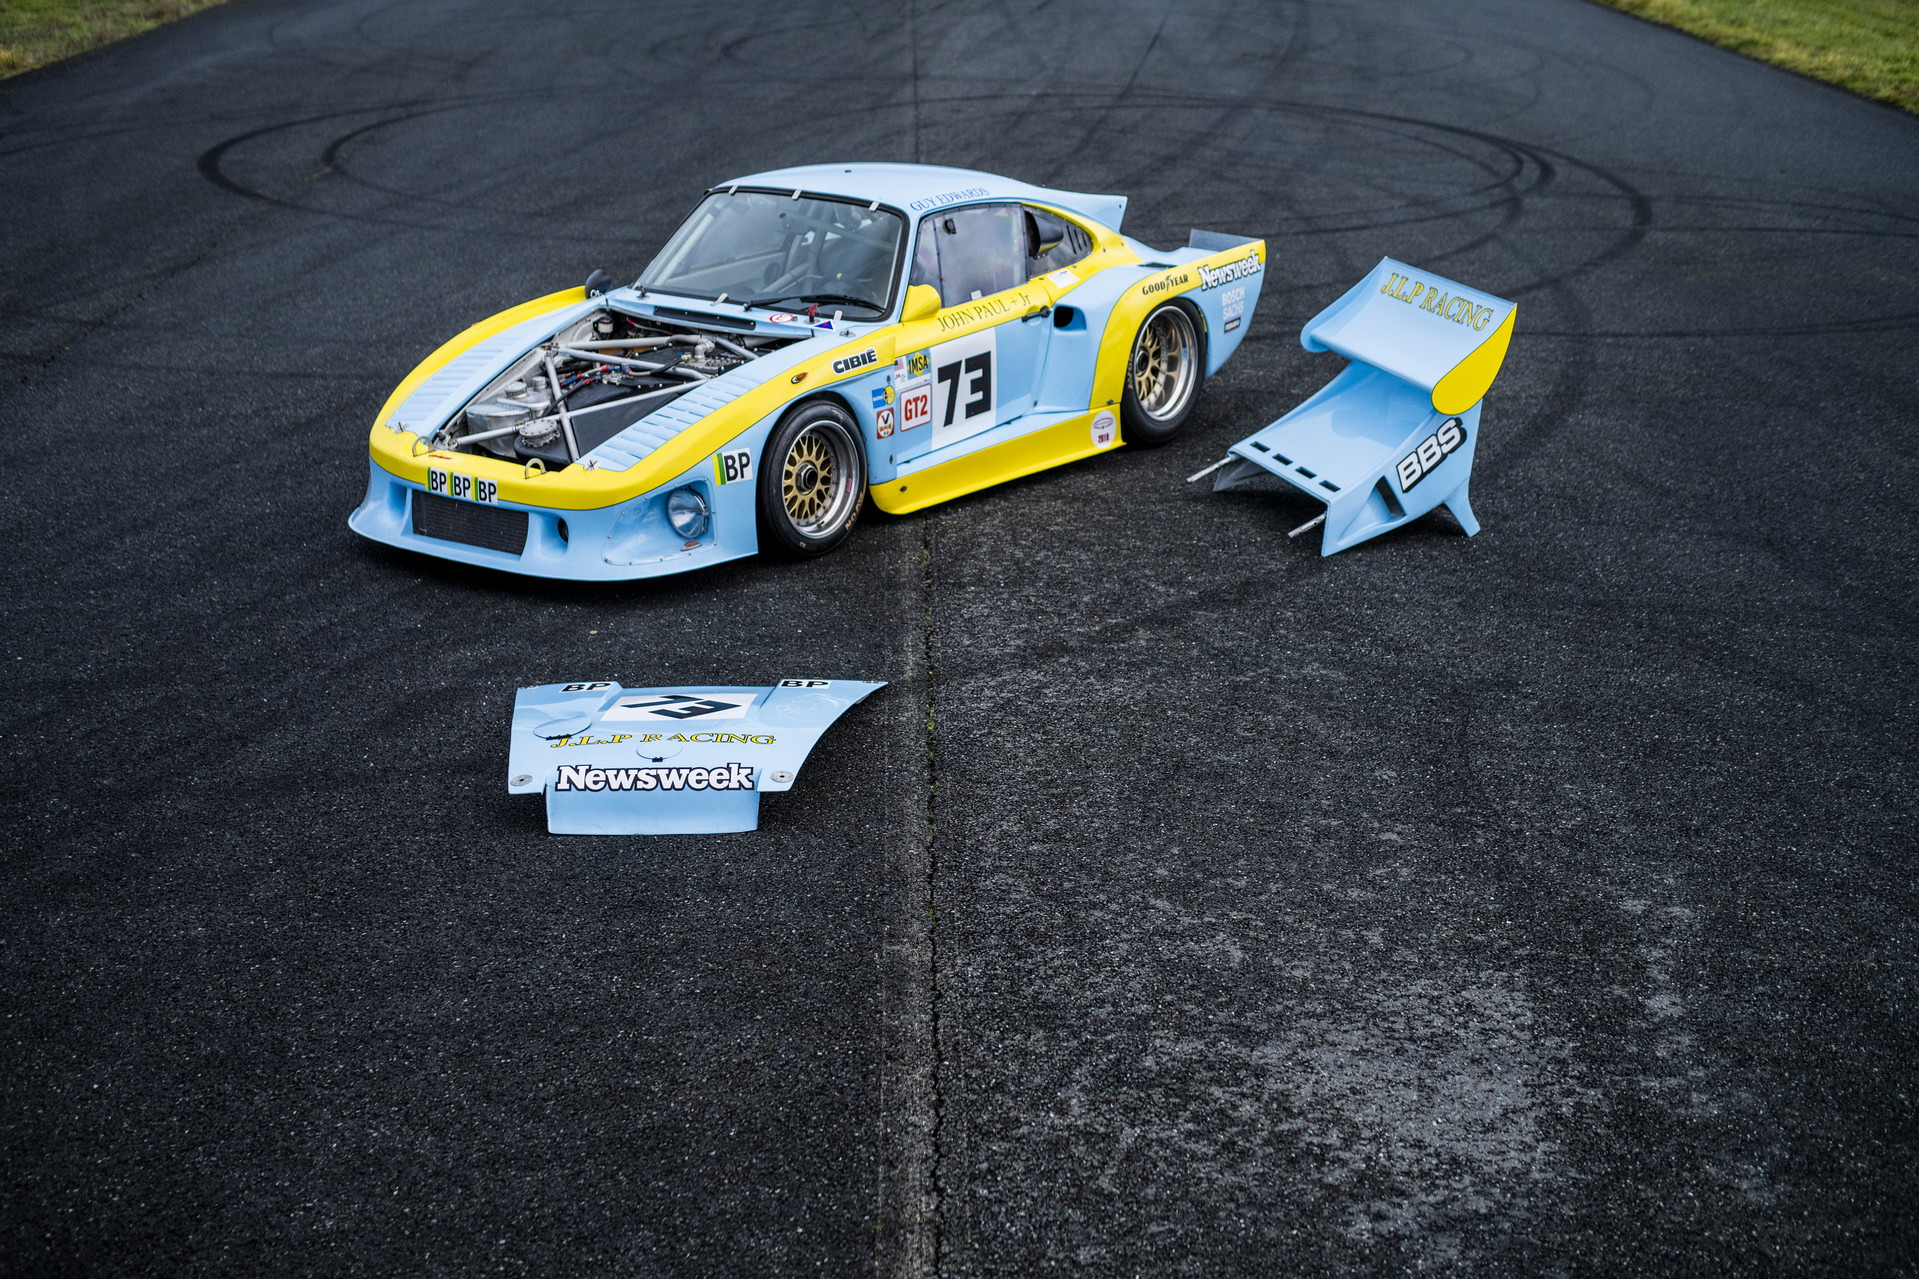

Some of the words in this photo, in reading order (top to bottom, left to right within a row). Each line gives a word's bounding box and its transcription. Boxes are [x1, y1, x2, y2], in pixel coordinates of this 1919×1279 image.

[909, 197, 937, 212] GUY
[934, 187, 990, 205] EDWARDS
[1197, 250, 1261, 292] Newsweek
[937, 311, 975, 332] JOHN
[975, 298, 1010, 325] PAUL
[1018, 292, 1033, 311] Jr
[1222, 287, 1245, 307] BOSCH
[1380, 272, 1425, 304] J.L.P
[1419, 287, 1494, 332] RACING
[908, 355, 929, 375] IMSA
[937, 350, 991, 428] 73
[904, 394, 928, 422] GT2
[723, 452, 750, 482] BP
[1396, 417, 1467, 493] BBS
[431, 470, 447, 493] BP
[453, 475, 471, 498] BP
[478, 480, 497, 503] BP
[845, 491, 863, 530] AVON
[560, 682, 612, 692] BP
[780, 680, 830, 688] BP
[620, 694, 742, 720] 73
[640, 732, 776, 746] RACING
[555, 763, 754, 793] Newsweek
